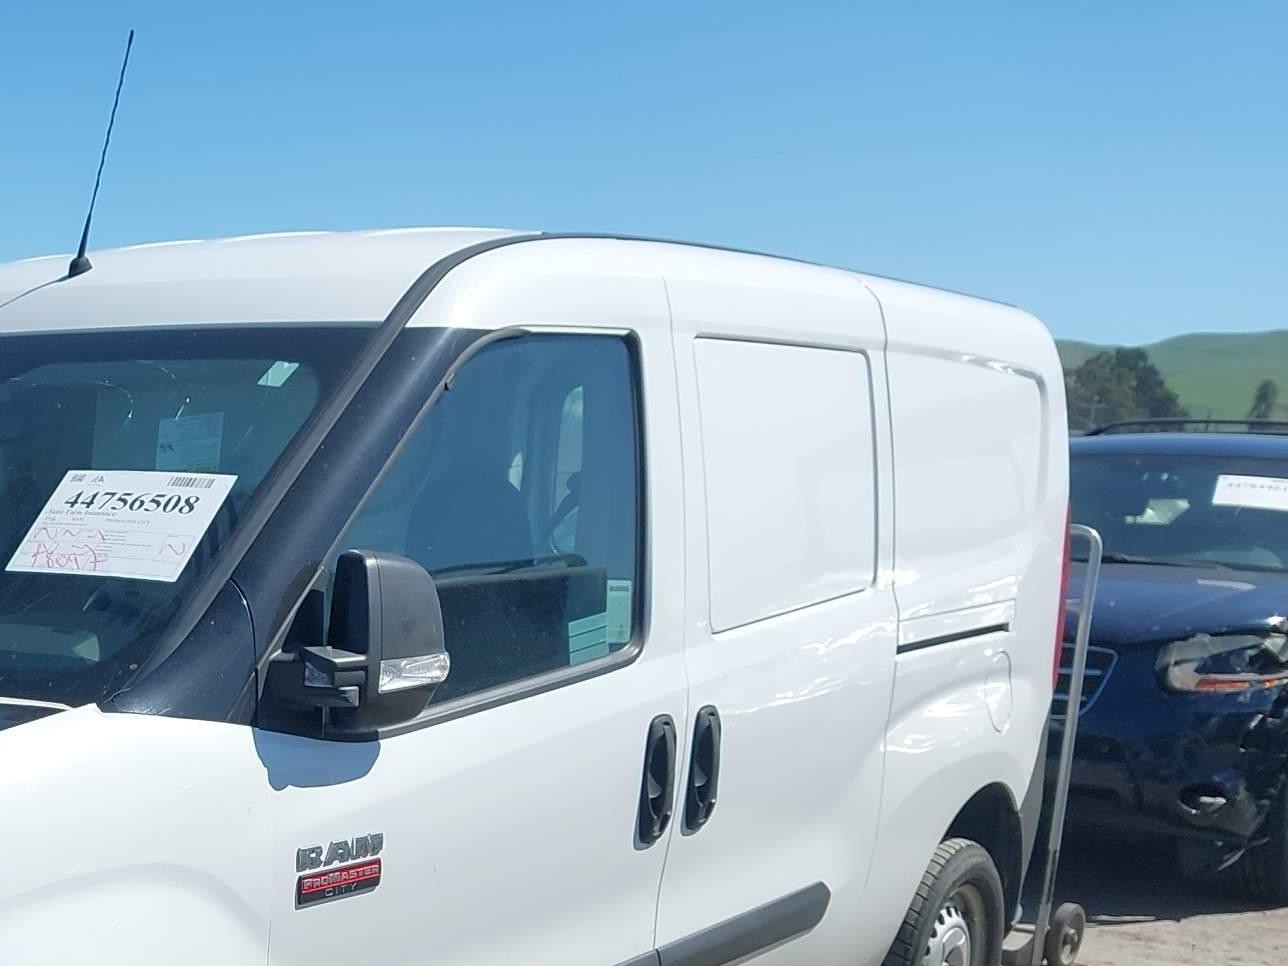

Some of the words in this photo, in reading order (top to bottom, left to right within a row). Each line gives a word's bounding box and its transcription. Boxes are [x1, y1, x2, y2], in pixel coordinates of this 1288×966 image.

[64, 489, 201, 516] 44756508
[296, 832, 384, 873] RAM
[302, 864, 380, 890] PROMASTER
[325, 882, 359, 897] CITY
